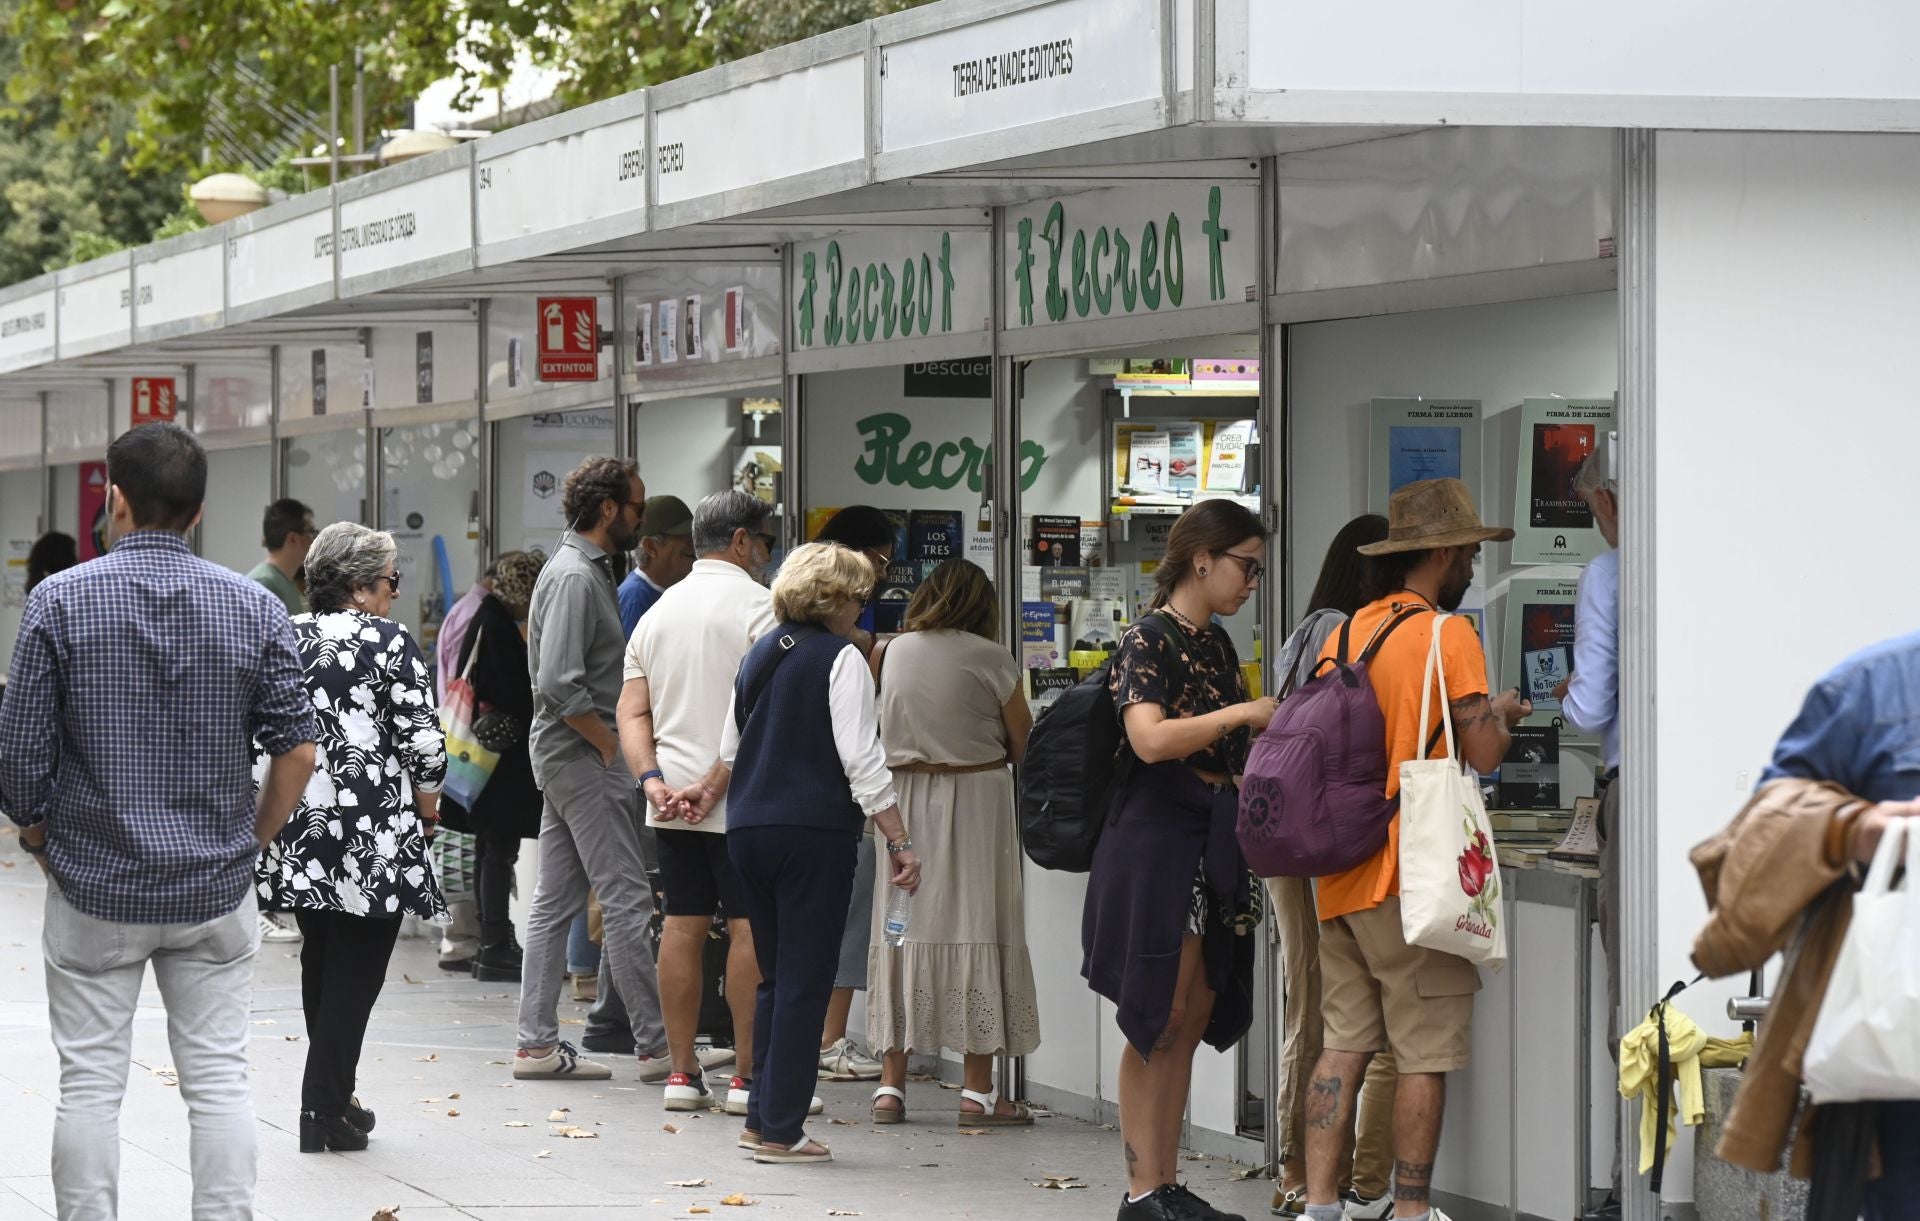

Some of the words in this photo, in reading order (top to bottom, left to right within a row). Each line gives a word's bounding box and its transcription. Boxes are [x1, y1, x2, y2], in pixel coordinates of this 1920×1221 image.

[953, 59, 983, 98] TIERRA
[986, 56, 997, 91] DE
[1000, 48, 1026, 88] NADIE
[1028, 37, 1073, 82] EDITORES
[619, 140, 645, 181] LIBRERÍA
[658, 142, 684, 174] RECREO
[1039, 201, 1184, 323] Recreo
[824, 240, 933, 346] Recreo
[543, 362, 593, 374] EXTINTOR
[854, 412, 1049, 493] Recro
[927, 532, 946, 541] LOS
[922, 544, 950, 556] TRES
[1060, 579, 1082, 587] CAMINO
[1035, 678, 1047, 687] LA
[1048, 678, 1075, 687] DAMA
[1534, 680, 1544, 690] No
[1454, 914, 1493, 939] Granada
